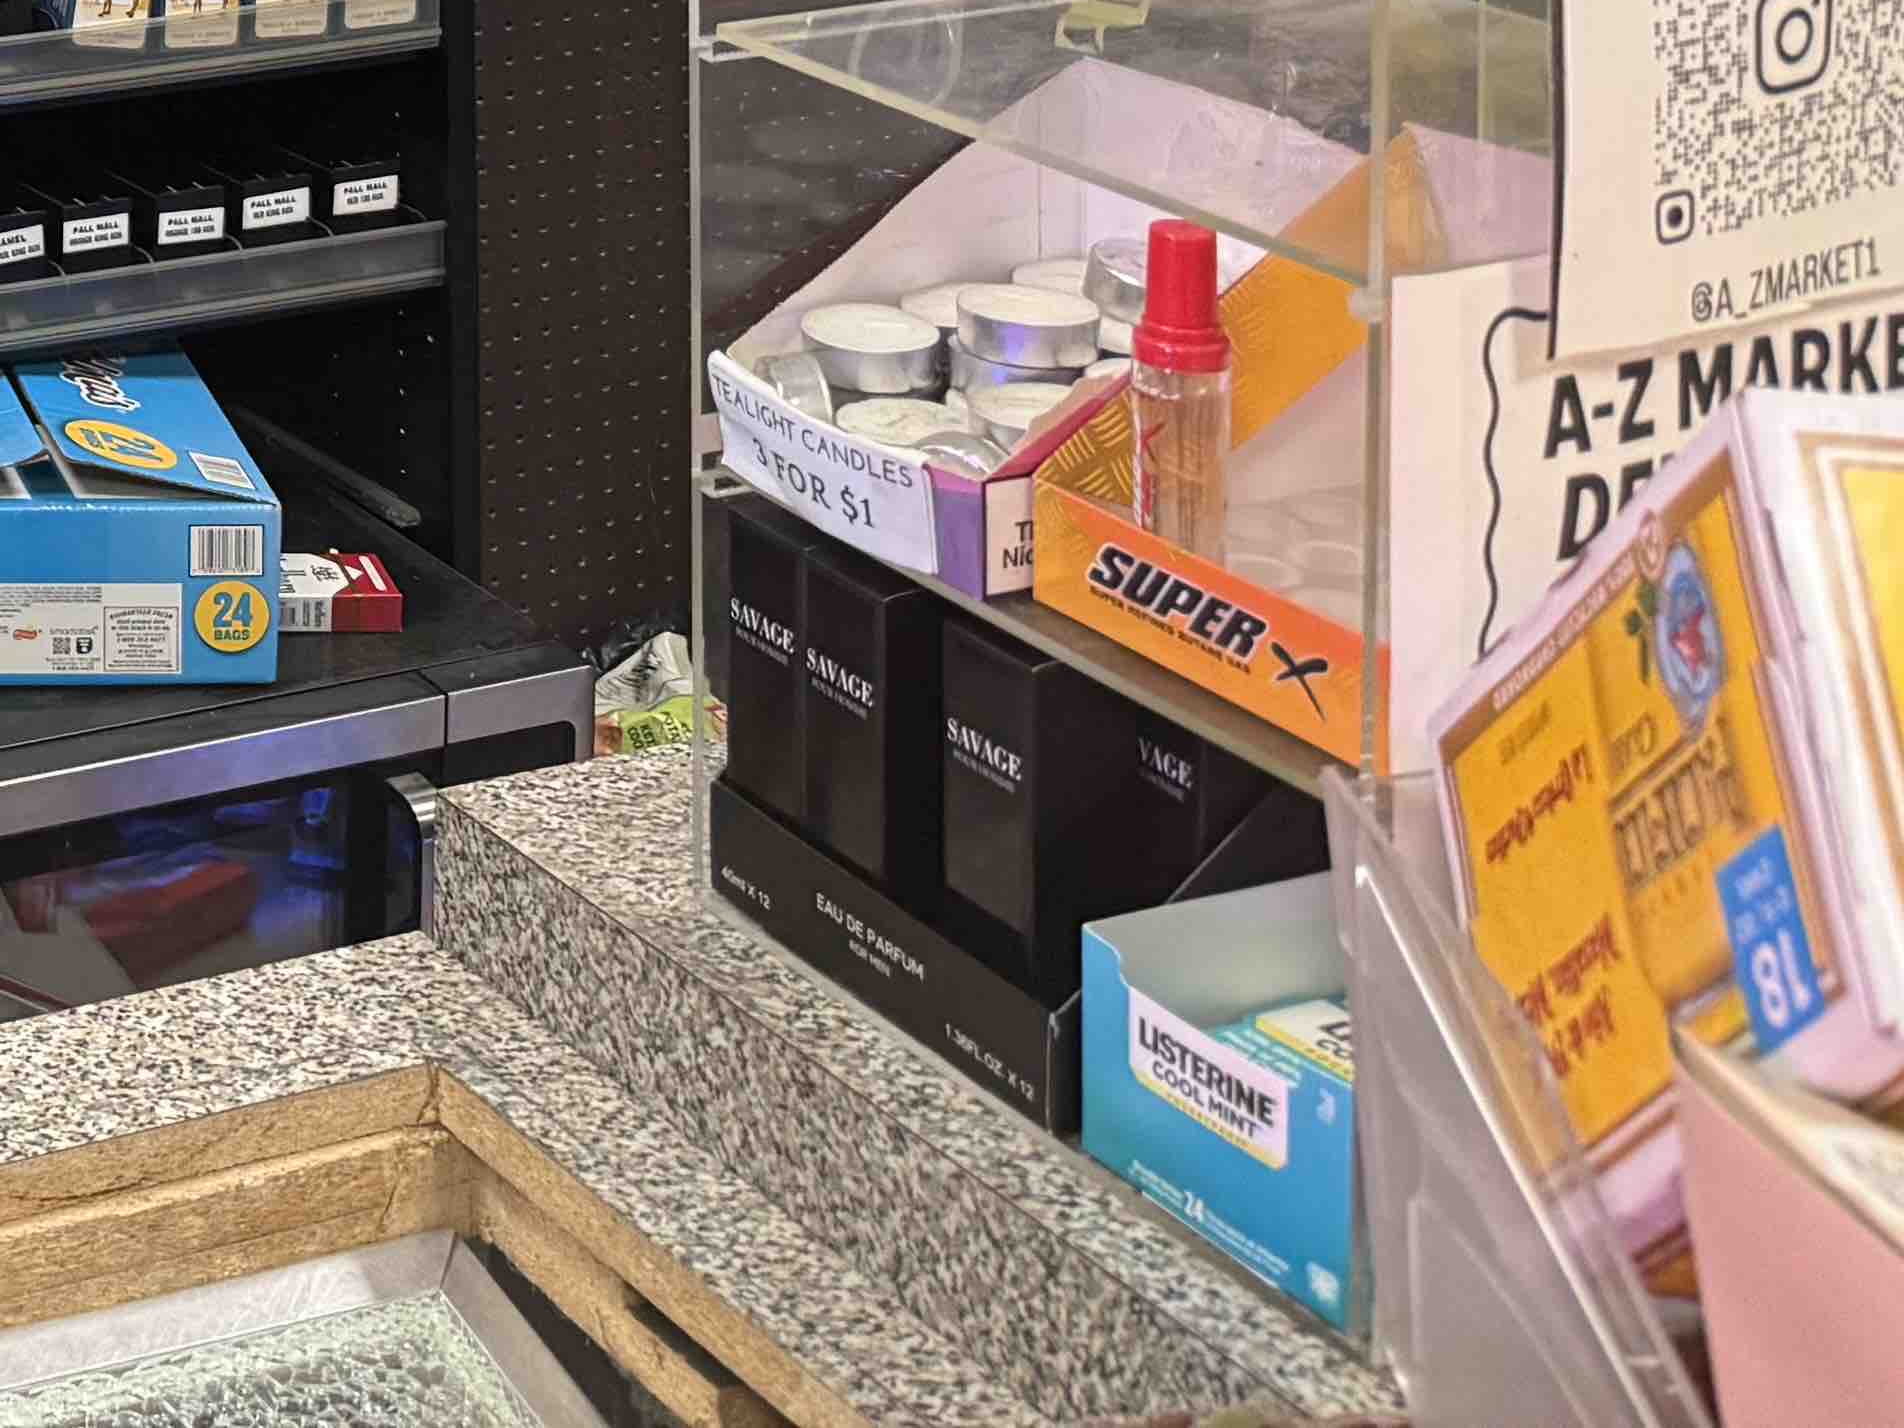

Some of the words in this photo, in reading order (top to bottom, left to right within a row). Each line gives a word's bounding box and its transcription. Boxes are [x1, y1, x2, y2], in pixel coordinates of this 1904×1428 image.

[1692, 245, 1880, 322] @A_ZMARKET1
[712, 375, 795, 439] TEALIGHT
[801, 430, 913, 488] CANDLES
[755, 439, 769, 467] 3
[776, 461, 830, 509] FOR
[841, 486, 874, 529] $1
[212, 592, 252, 627] 24
[215, 629, 250, 640] BAGS
[730, 597, 794, 653] SAVAGE
[1086, 544, 1266, 660] SUPER
[807, 648, 872, 707] SAVAGE
[815, 893, 843, 925] EAU
[846, 912, 865, 937] DE
[866, 926, 925, 981] PARFUM
[1138, 1017, 1276, 1127] LISTERINE
[1152, 1060, 1205, 1107] COOL
[1208, 1099, 1257, 1139] MINT
